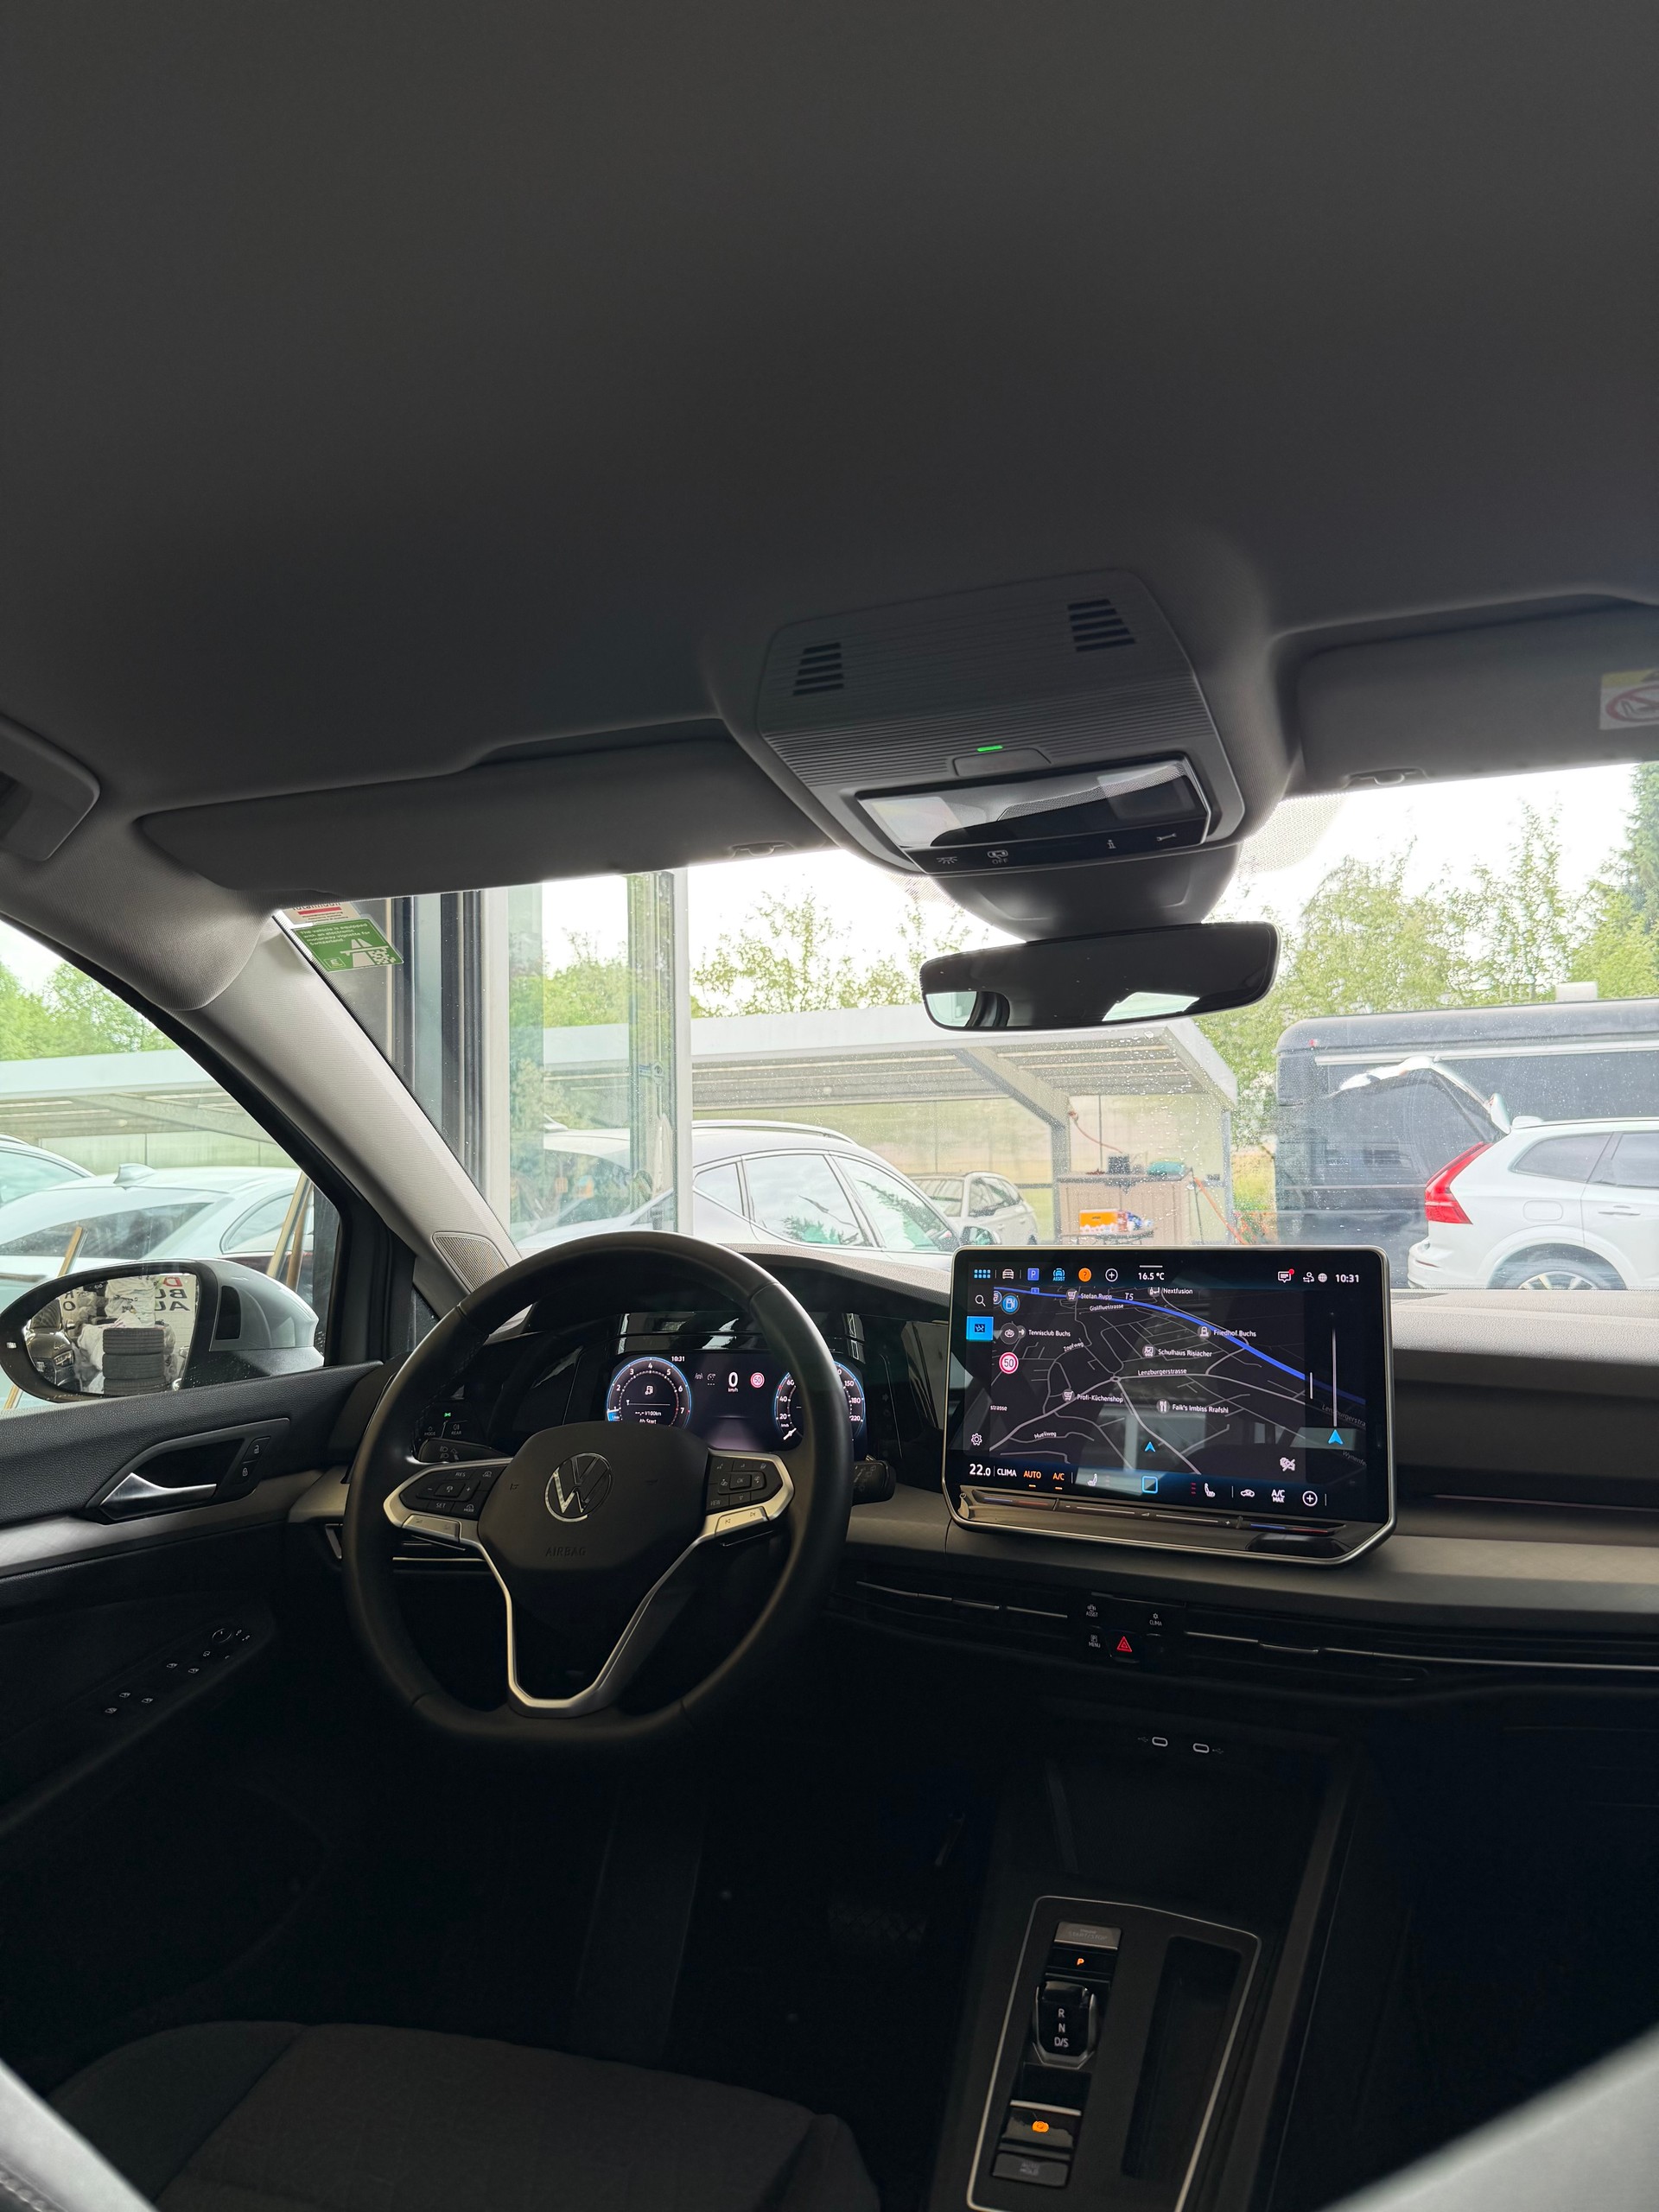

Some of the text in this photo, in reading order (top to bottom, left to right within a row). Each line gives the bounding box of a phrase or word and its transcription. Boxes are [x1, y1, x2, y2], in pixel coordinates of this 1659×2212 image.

[1004, 1358, 1014, 1368] 50
[1138, 1368, 1187, 1376] Lenzburgerstrasse
[728, 1371, 739, 1388] 0
[1077, 1395, 1123, 1404] Profi-Küchenshop
[969, 1464, 991, 1477] 22.0
[996, 1468, 1017, 1478] CLIMA
[1023, 1471, 1042, 1479] AUTO
[1052, 1472, 1065, 1481] A/C
[1271, 1489, 1285, 1497] A/C
[545, 1547, 588, 1557] AIRBAG
[1058, 2007, 1065, 2018] R
[1058, 2023, 1065, 2033] N
[1054, 2037, 1069, 2048] D/S
